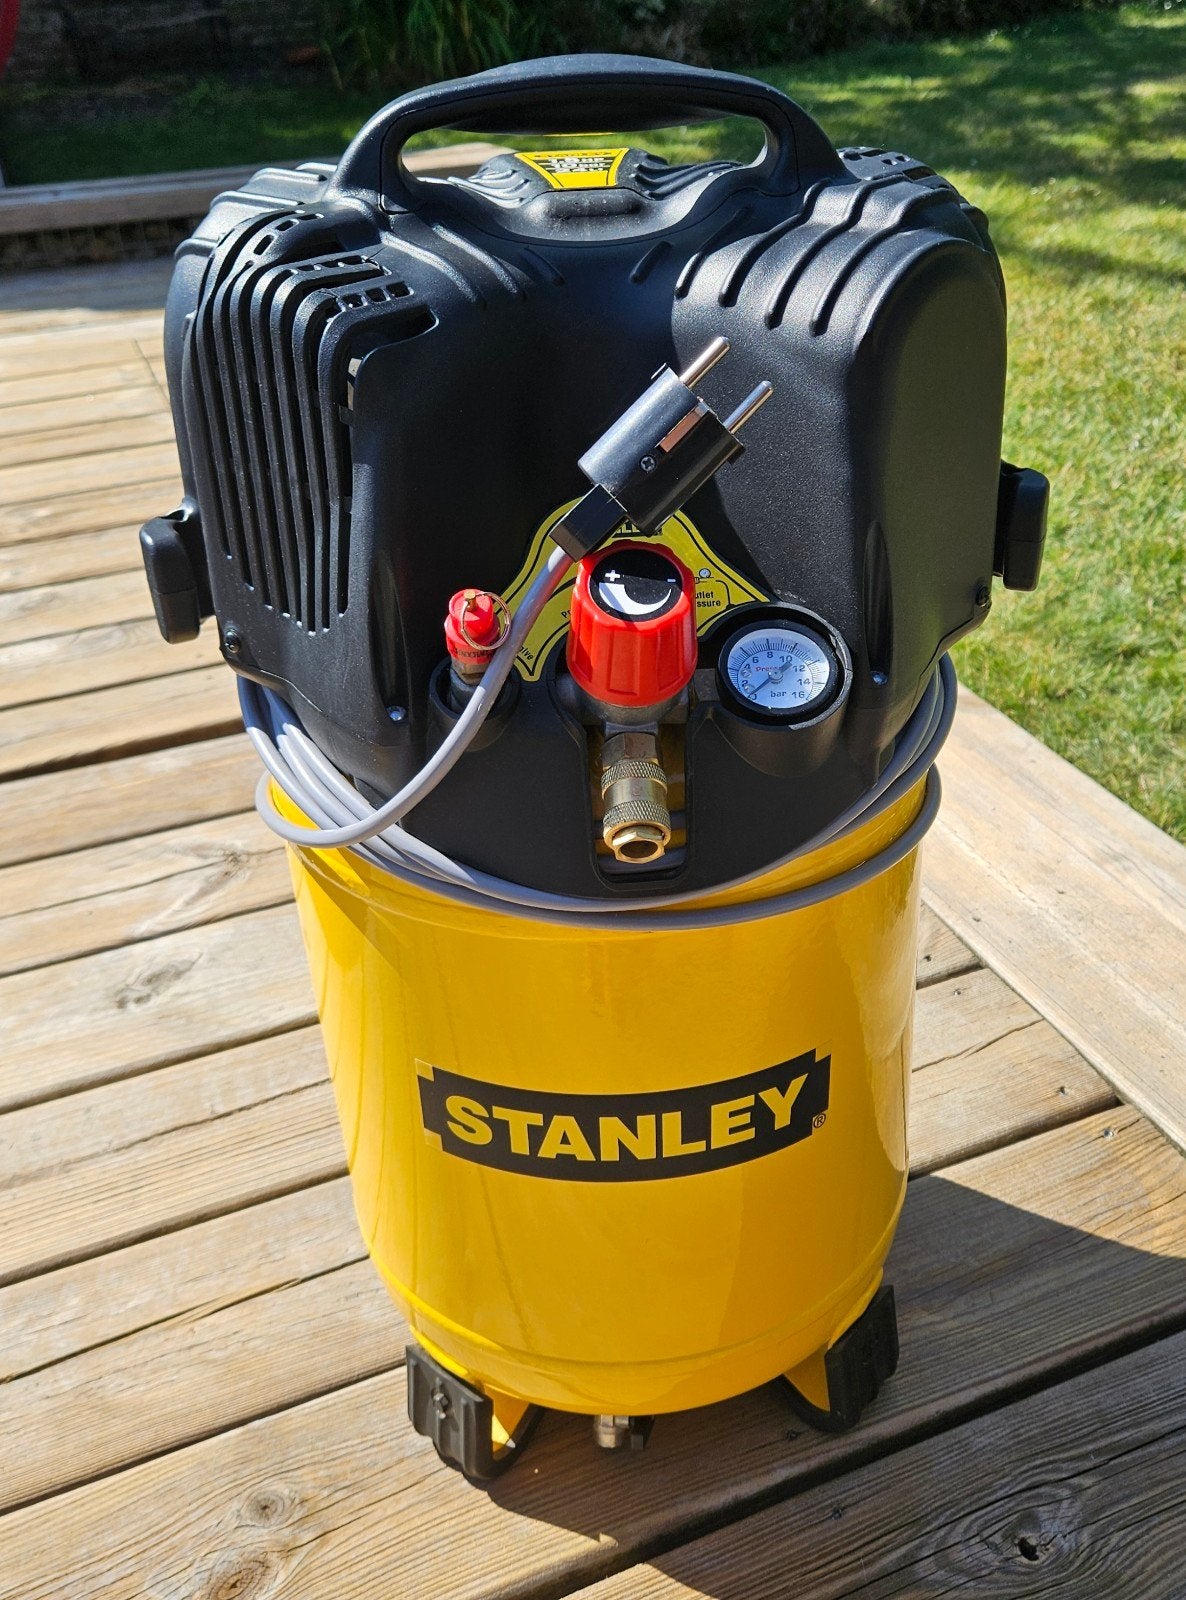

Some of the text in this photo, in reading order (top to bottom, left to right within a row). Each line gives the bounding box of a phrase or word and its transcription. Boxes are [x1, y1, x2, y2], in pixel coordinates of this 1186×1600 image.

[696, 600, 721, 608] ssure
[797, 678, 811, 686] 14
[770, 690, 787, 698] bar
[791, 691, 805, 699] 16
[445, 1073, 809, 1162] STANLEY
